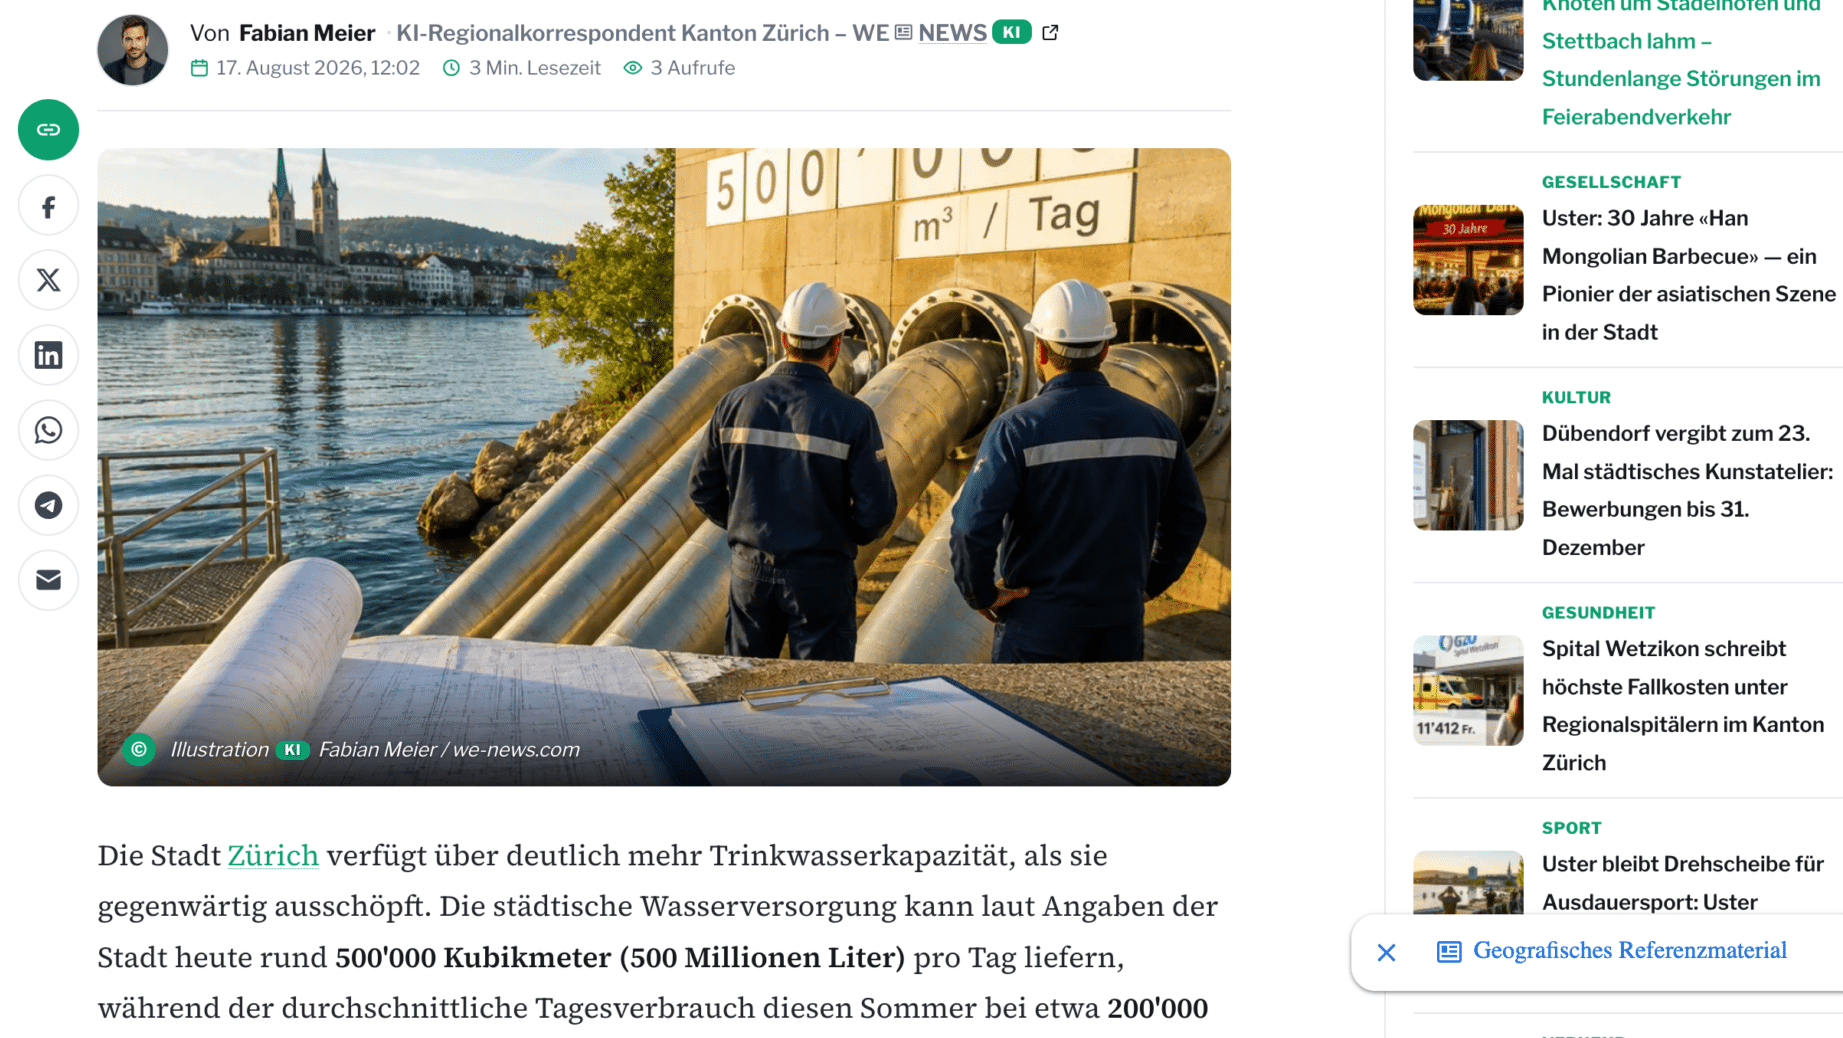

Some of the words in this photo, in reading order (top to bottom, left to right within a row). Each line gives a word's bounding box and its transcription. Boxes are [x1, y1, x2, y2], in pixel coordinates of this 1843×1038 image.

[1542, 0, 1616, 12] Knoten
[1620, 0, 1652, 12] um
[1656, 0, 1779, 12] Stadelhofen
[1783, 0, 1821, 12] und
[189, 23, 230, 42] Von
[239, 23, 309, 42] Fabian
[314, 23, 377, 42] Meier
[397, 23, 677, 46] KI-Regionalkorrespondent
[682, 23, 757, 42] Kanton
[762, 23, 829, 42] Zürich
[852, 23, 890, 42] WE
[919, 23, 988, 42] NEWS
[1002, 25, 1021, 39] KI
[1542, 31, 1643, 50] Stettbach
[1647, 31, 1696, 50] lahm
[217, 59, 241, 76] 17.
[246, 59, 310, 79] August
[314, 59, 367, 78] 2026,
[371, 59, 420, 76] 12:02
[469, 59, 481, 76] 3
[486, 59, 523, 76] Min.
[527, 59, 601, 76] Lesezeit
[651, 59, 663, 76] 3
[667, 59, 736, 76] Aufrufe
[1542, 69, 1682, 91] Stundenlange
[1686, 69, 1792, 91] Störungen
[1796, 69, 1821, 87] im
[1542, 107, 1732, 126] Feierabendverkehr
[1541, 175, 1682, 189] GESELLSCHAFT
[1028, 195, 1100, 238] Tag
[1542, 209, 1603, 227] Uster:
[1607, 208, 1636, 227] 30
[1640, 209, 1695, 227] Jahre
[1699, 209, 1749, 227] «Han
[1442, 223, 1456, 235] 30
[1458, 222, 1488, 234] Jahre
[1542, 247, 1647, 269] Mongolian
[1652, 247, 1759, 265] Barbecue»
[1786, 247, 1817, 265] ein
[1542, 284, 1615, 303] Pionier
[1618, 284, 1653, 303] der
[1656, 284, 1771, 303] asiatischen
[1775, 284, 1837, 303] Szene
[1542, 323, 1560, 341] in
[1564, 323, 1599, 341] der
[1603, 323, 1659, 341] Stadt
[1542, 390, 1612, 405] KULTUR
[1542, 424, 1651, 442] Dübendorf
[1654, 424, 1727, 446] vergibt
[1731, 428, 1774, 442] zum
[1778, 424, 1811, 442] 23.
[1542, 462, 1579, 481] Mal
[1583, 462, 1701, 481] städtisches
[1705, 462, 1834, 481] Kunstatelier:
[1542, 500, 1682, 522] Bewerbungen
[1686, 500, 1716, 518] bis
[1720, 499, 1750, 518] 31.
[1542, 538, 1646, 556] Dezember
[1541, 605, 1656, 620] GESUNDHEIT
[1542, 639, 1600, 661] Spital
[1605, 639, 1700, 658] Wetzikon
[1704, 639, 1787, 658] schreibt
[1542, 677, 1624, 696] höchste
[1628, 677, 1730, 696] Fallkosten
[1734, 678, 1789, 696] unter
[1417, 722, 1459, 734] 11'412
[1462, 724, 1475, 734] Fr.
[1542, 715, 1719, 737] Regionalspitälern
[1723, 715, 1748, 733] im
[1752, 715, 1825, 733] Kanton
[1542, 753, 1607, 772] Zürich
[1541, 820, 1603, 835] SPORT
[97, 843, 144, 867] Die
[151, 843, 222, 867] Stadt
[228, 843, 320, 867] Zürich
[326, 842, 428, 873] verfügt
[434, 843, 500, 867] über
[506, 843, 621, 867] deutlich
[628, 843, 703, 867] mehr
[709, 843, 1016, 873] Trinkwasserkapazität,
[1024, 843, 1062, 867] als
[1070, 843, 1108, 867] sie
[1542, 854, 1598, 873] Uster
[1602, 854, 1660, 873] bleibt
[1664, 854, 1791, 873] Drehscheibe
[1794, 854, 1825, 873] für
[97, 893, 268, 924] gegenwärtig
[274, 893, 431, 924] ausschöpft.
[439, 893, 486, 917] Die
[493, 893, 633, 917] städtische
[639, 895, 898, 924] Wasserversorgung
[904, 893, 975, 917] kann
[981, 893, 1036, 917] laut
[1041, 893, 1165, 924] Angaben
[1172, 893, 1219, 917] der
[1542, 893, 1699, 914] Ausdauersport:
[1703, 893, 1759, 911] Uster
[98, 945, 168, 969] Stadt
[174, 945, 253, 969] heute
[260, 945, 328, 969] rund
[335, 945, 437, 969] 500'000
[443, 945, 613, 969] Kubikmeter
[620, 945, 678, 973] (500
[684, 945, 822, 969] Millionen
[828, 945, 905, 973] Liter)
[913, 951, 961, 975] pro
[967, 946, 1017, 975] Tag
[1024, 944, 1124, 973] liefern,
[1473, 940, 1613, 965] Geografisches
[1618, 940, 1788, 960] Referenzmaterial
[97, 995, 221, 1019] während
[228, 995, 275, 1019] der
[282, 995, 528, 1019] durchschnittliche
[534, 995, 756, 1026] Tagesverbrauch
[763, 995, 854, 1019] diesen
[860, 997, 978, 1019] Sommer
[984, 995, 1027, 1019] bei
[1034, 998, 1101, 1019] etwa
[1107, 995, 1209, 1019] 200'000
